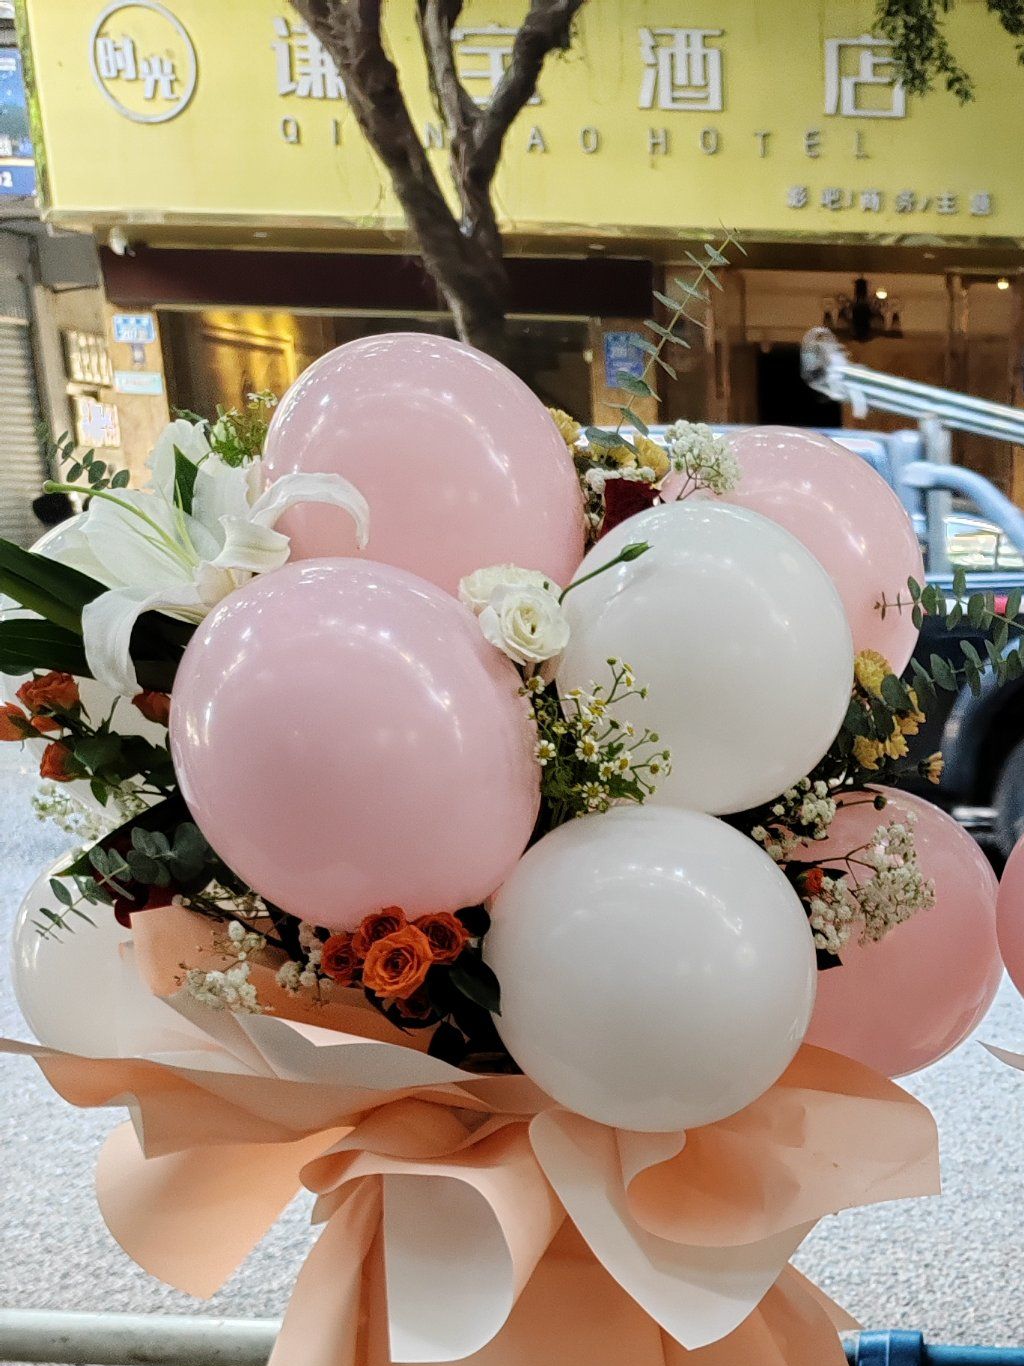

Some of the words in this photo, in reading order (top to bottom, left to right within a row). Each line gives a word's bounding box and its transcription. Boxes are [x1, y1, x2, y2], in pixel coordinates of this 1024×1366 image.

[96, 36, 178, 100] 时光
[279, 115, 599, 154] QINAO
[647, 126, 871, 159] HOTEL
